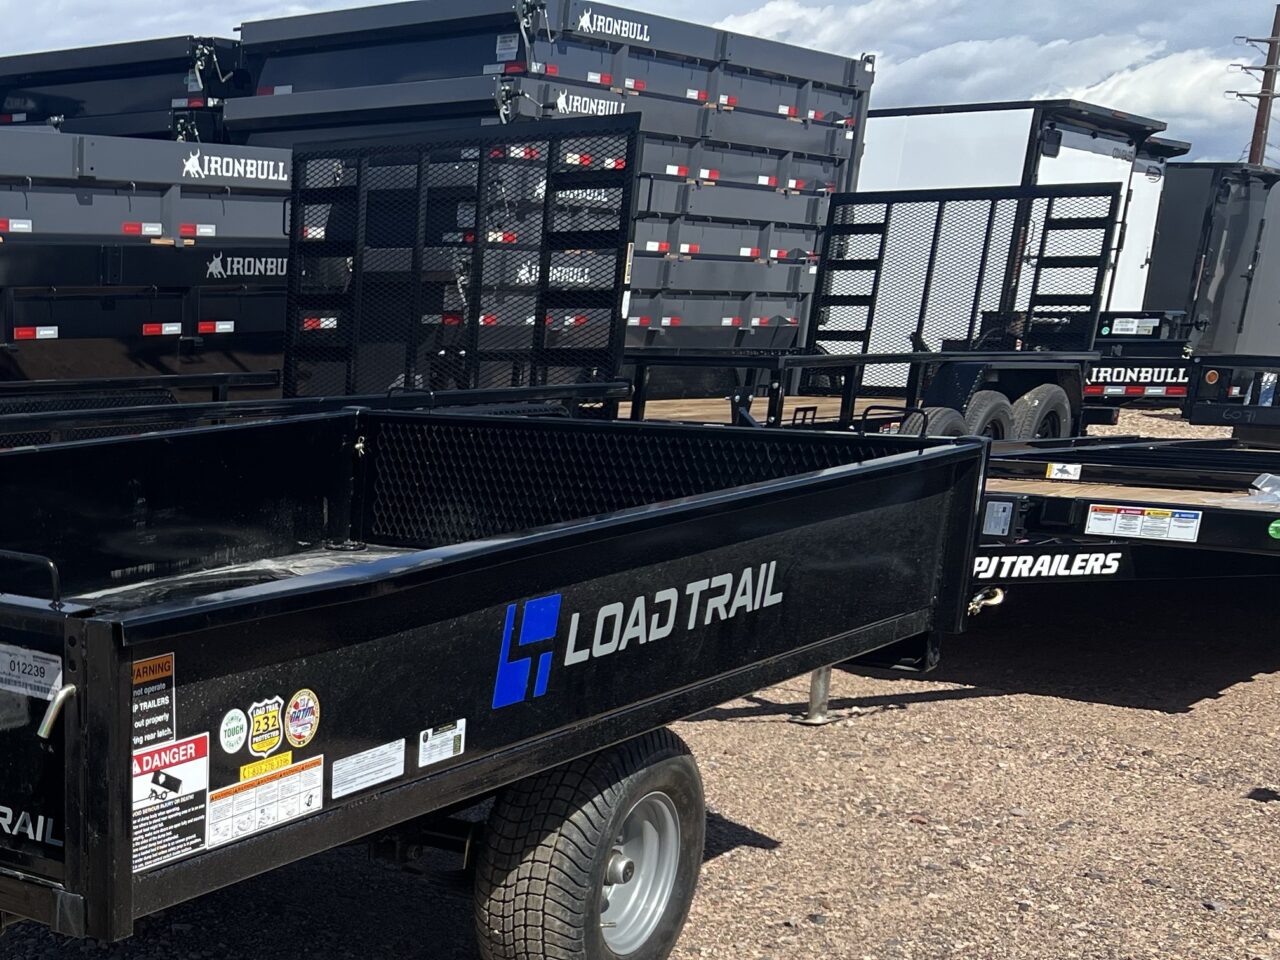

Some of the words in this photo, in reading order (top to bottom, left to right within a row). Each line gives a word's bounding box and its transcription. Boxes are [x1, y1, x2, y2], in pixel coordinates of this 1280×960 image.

[593, 14, 650, 42] IRONBULL
[204, 155, 288, 181] IRONBULL
[226, 257, 288, 276] IRONBU
[1091, 367, 1189, 383] IRONBULL
[973, 556, 999, 579] PJ
[999, 552, 1122, 578] TRAILERS
[564, 587, 678, 667] LOAD
[685, 560, 783, 630] TRAIL
[9, 659, 46, 678] 012239
[139, 695, 170, 711] TRAILERS
[224, 724, 244, 739] TOUGH
[255, 715, 277, 733] 232
[143, 743, 196, 772] DANGER
